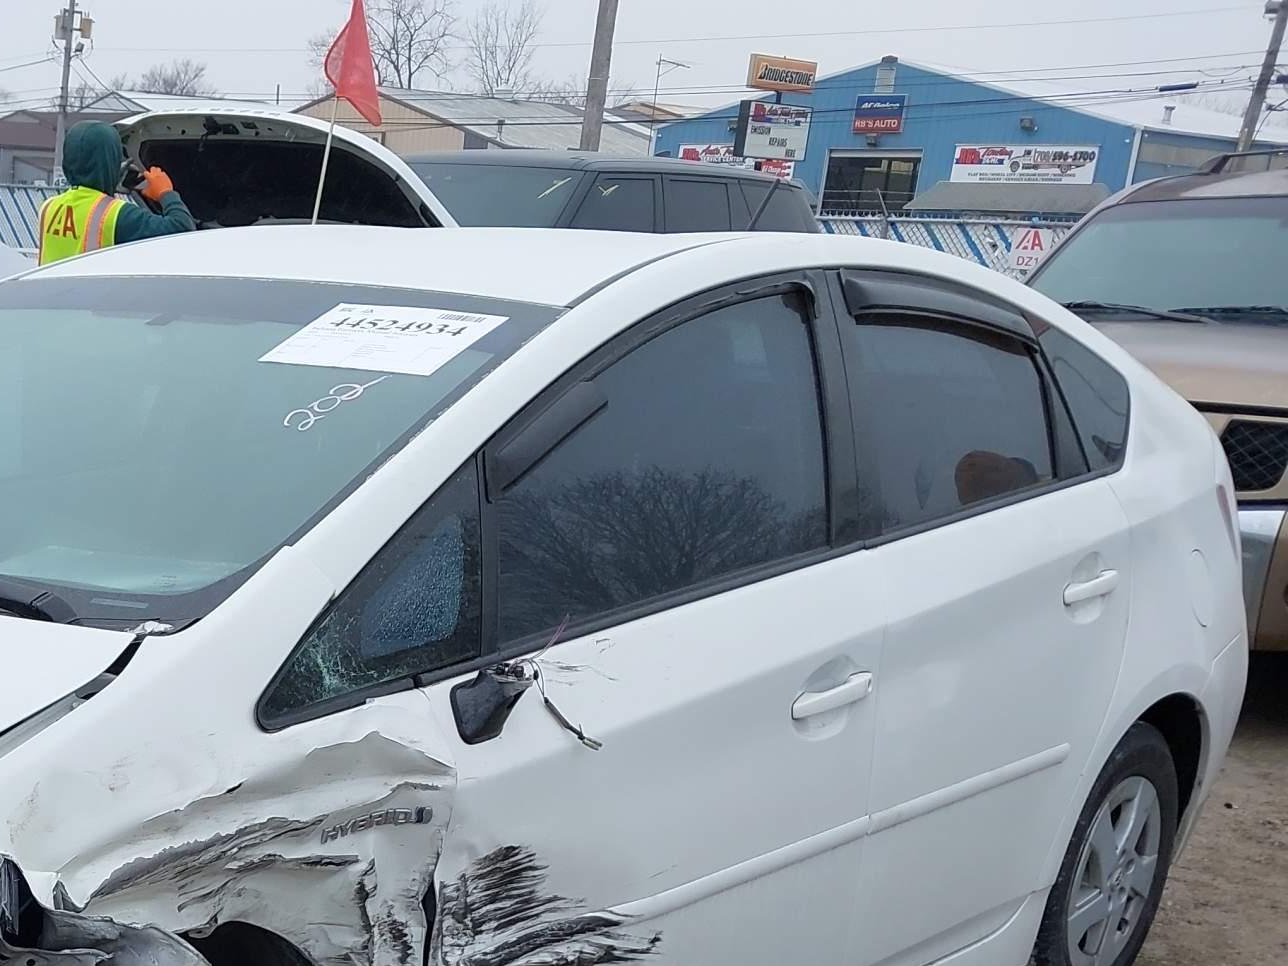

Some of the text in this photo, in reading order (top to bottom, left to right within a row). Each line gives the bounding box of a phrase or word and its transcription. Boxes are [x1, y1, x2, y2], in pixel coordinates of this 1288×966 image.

[758, 64, 813, 86] BRIDGESTONE
[874, 119, 898, 128] AUTO
[751, 126, 771, 135] EMISSION
[768, 137, 788, 147] REPAIRS
[785, 149, 796, 158] HERE
[329, 316, 468, 337] 44524934
[320, 807, 413, 845] HYBRID
